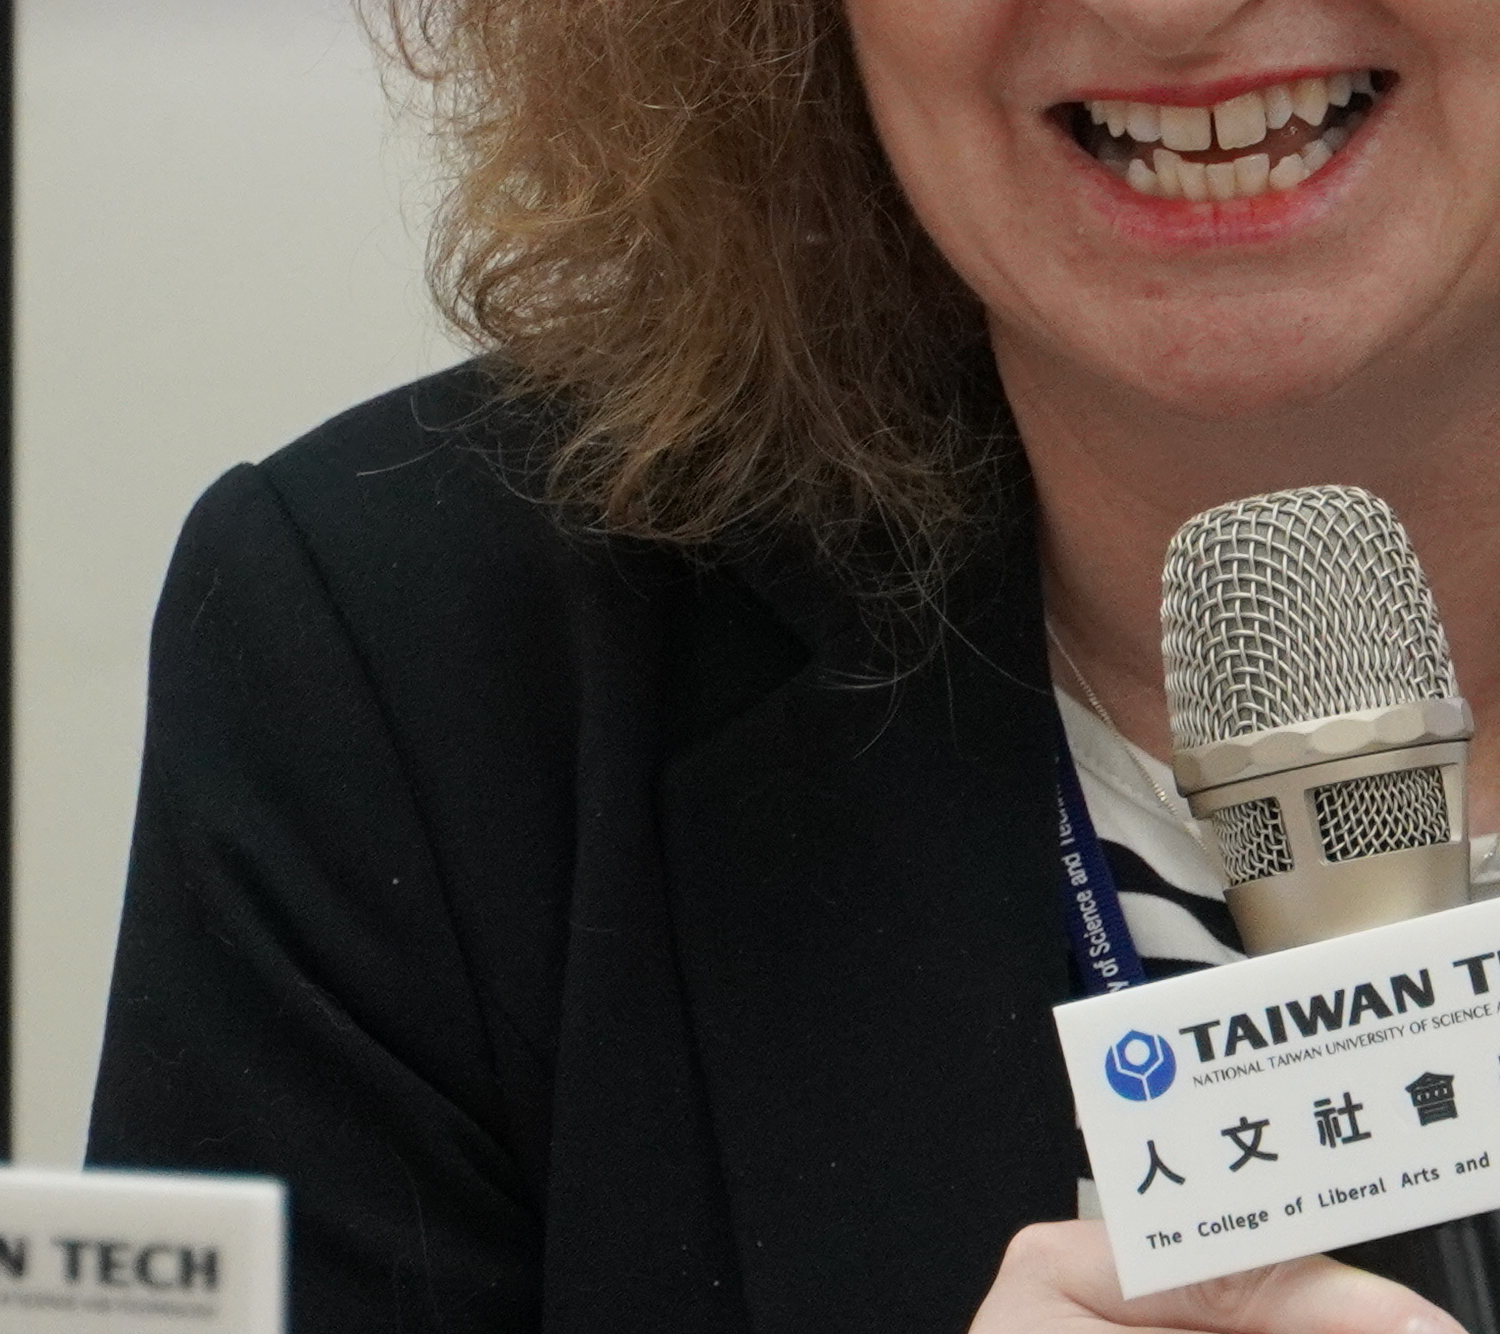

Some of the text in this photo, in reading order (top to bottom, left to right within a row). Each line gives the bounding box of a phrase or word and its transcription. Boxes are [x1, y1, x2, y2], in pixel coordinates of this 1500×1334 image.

[1077, 889, 1111, 958] Science
[1178, 968, 1436, 1063] TAIWAN
[1193, 1061, 1265, 1088] NATIONAL
[1266, 1046, 1323, 1069] TAIWAN
[1324, 1024, 1405, 1055] UNIVERSITY
[1409, 1017, 1430, 1035] OF
[1432, 1003, 1493, 1029] SCIENCE
[1145, 1230, 1183, 1250] The
[1197, 1208, 1269, 1239] College
[1284, 1196, 1303, 1217] of
[1318, 1176, 1388, 1208] Liberal
[1401, 1167, 1441, 1188] Arts
[1454, 1151, 1491, 1175] and
[52, 1234, 220, 1292] TECH
